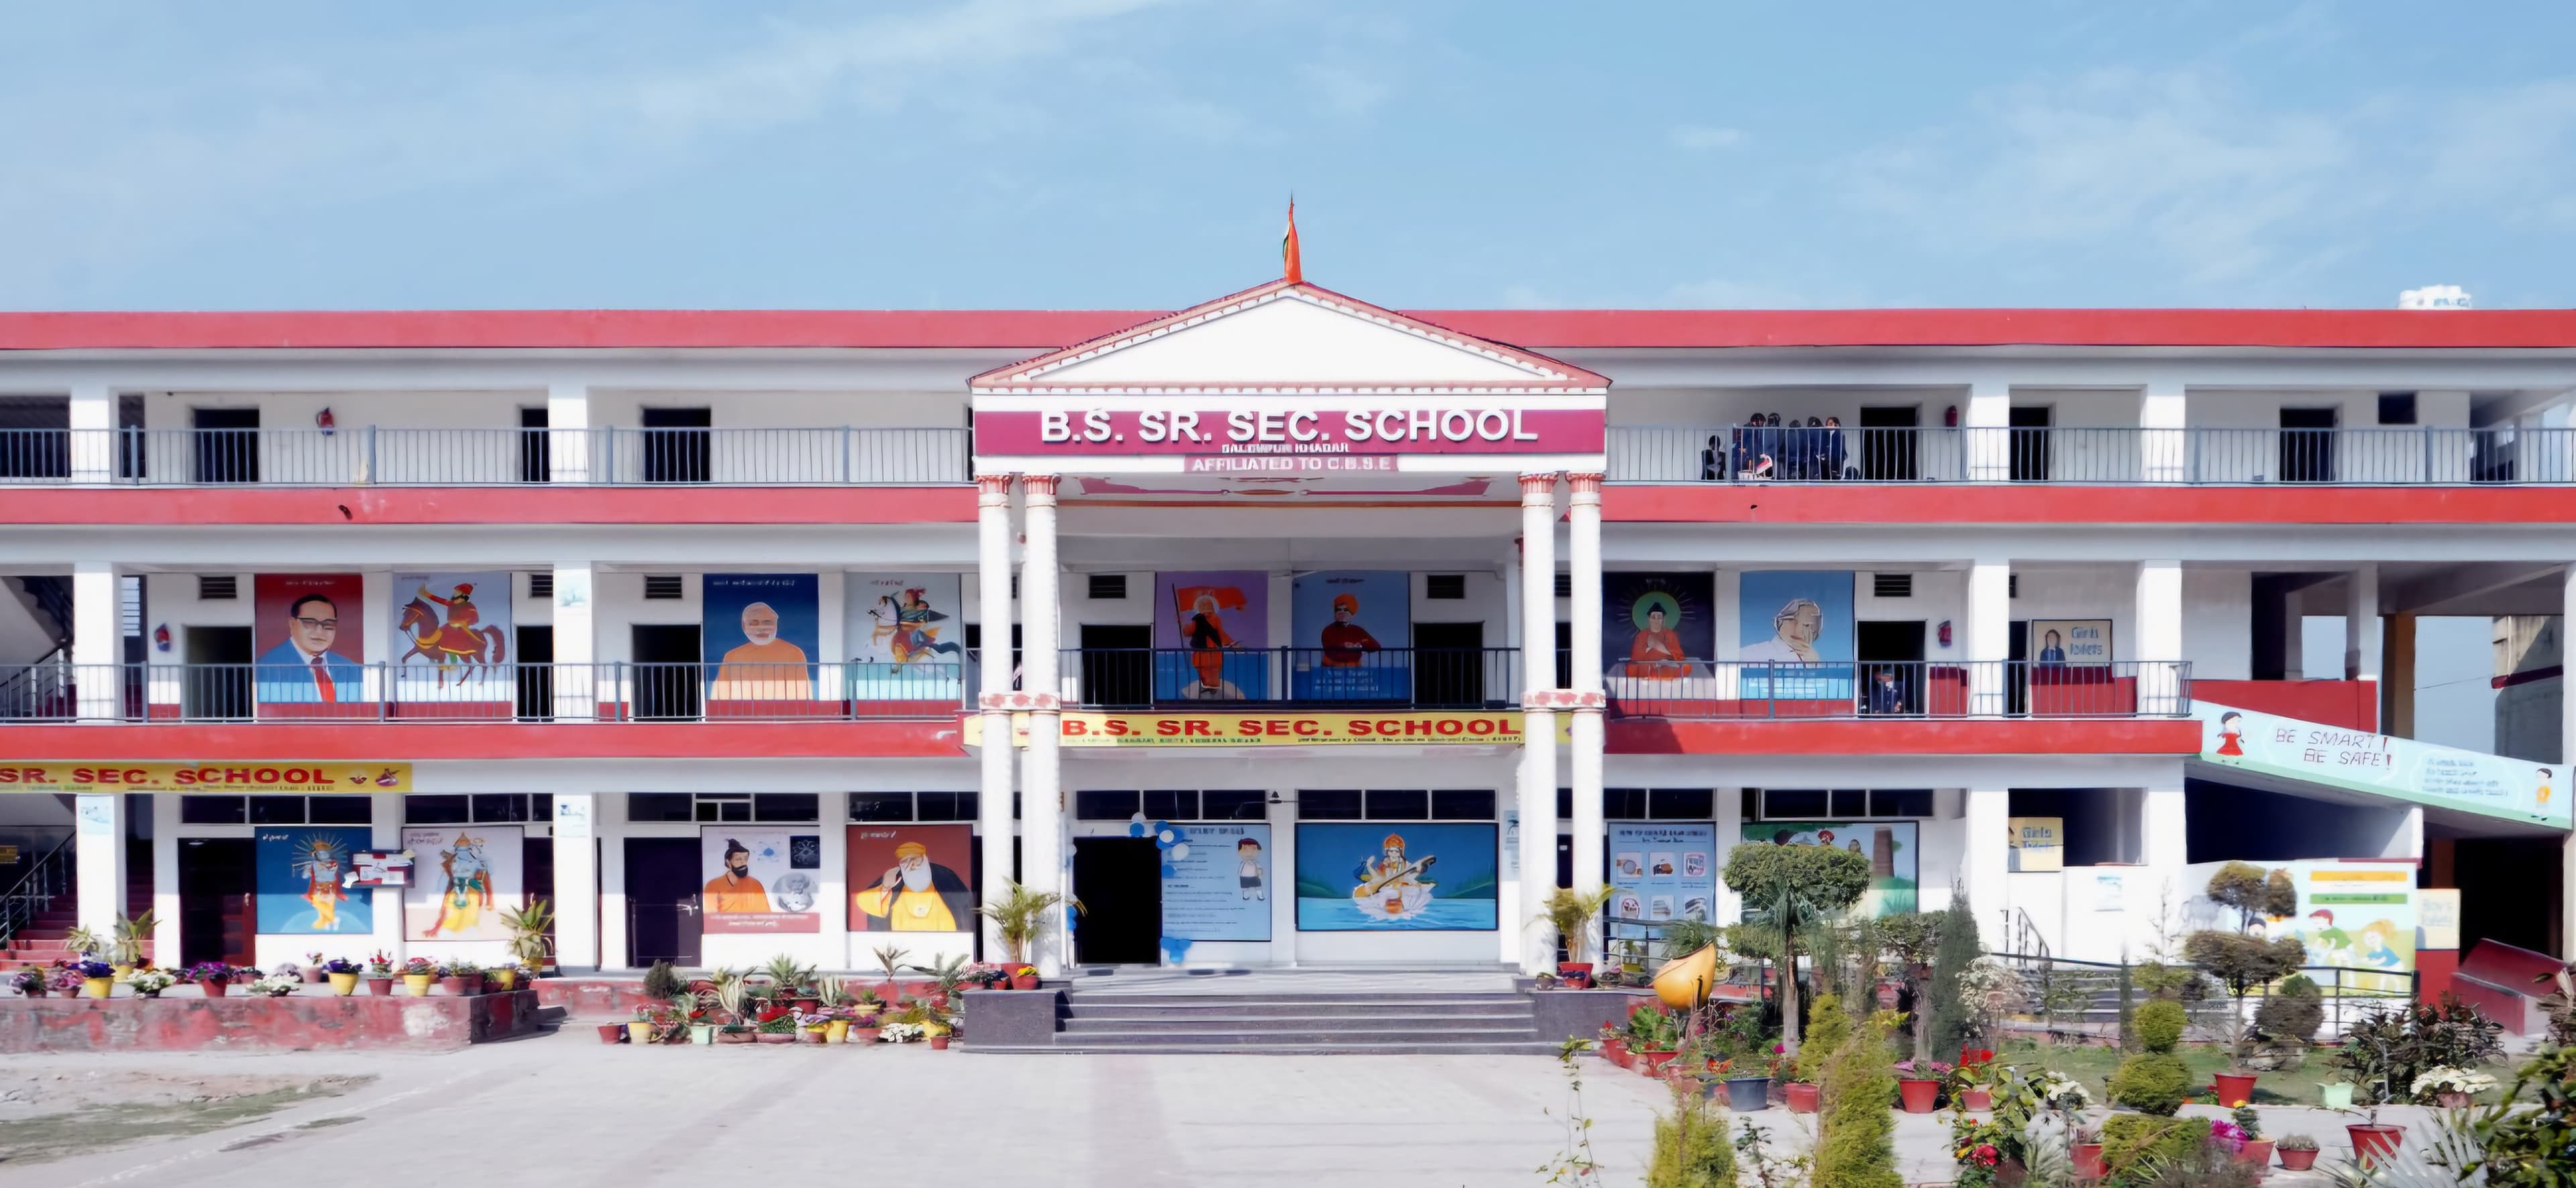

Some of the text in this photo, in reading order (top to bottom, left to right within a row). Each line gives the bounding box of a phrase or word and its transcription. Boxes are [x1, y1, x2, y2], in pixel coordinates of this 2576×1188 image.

[1041, 408, 1538, 443] B.S. SR. SEC. SCHOOL
[1191, 456, 1293, 472] AFFILIATED
[1301, 456, 1322, 471] TO
[1061, 718, 1521, 737] B.S. SR. SEC. SCHOOL
[2275, 728, 2298, 743] BE
[2304, 747, 2330, 763] BE
[0, 767, 335, 785] SR. SEC. SCHOOL
